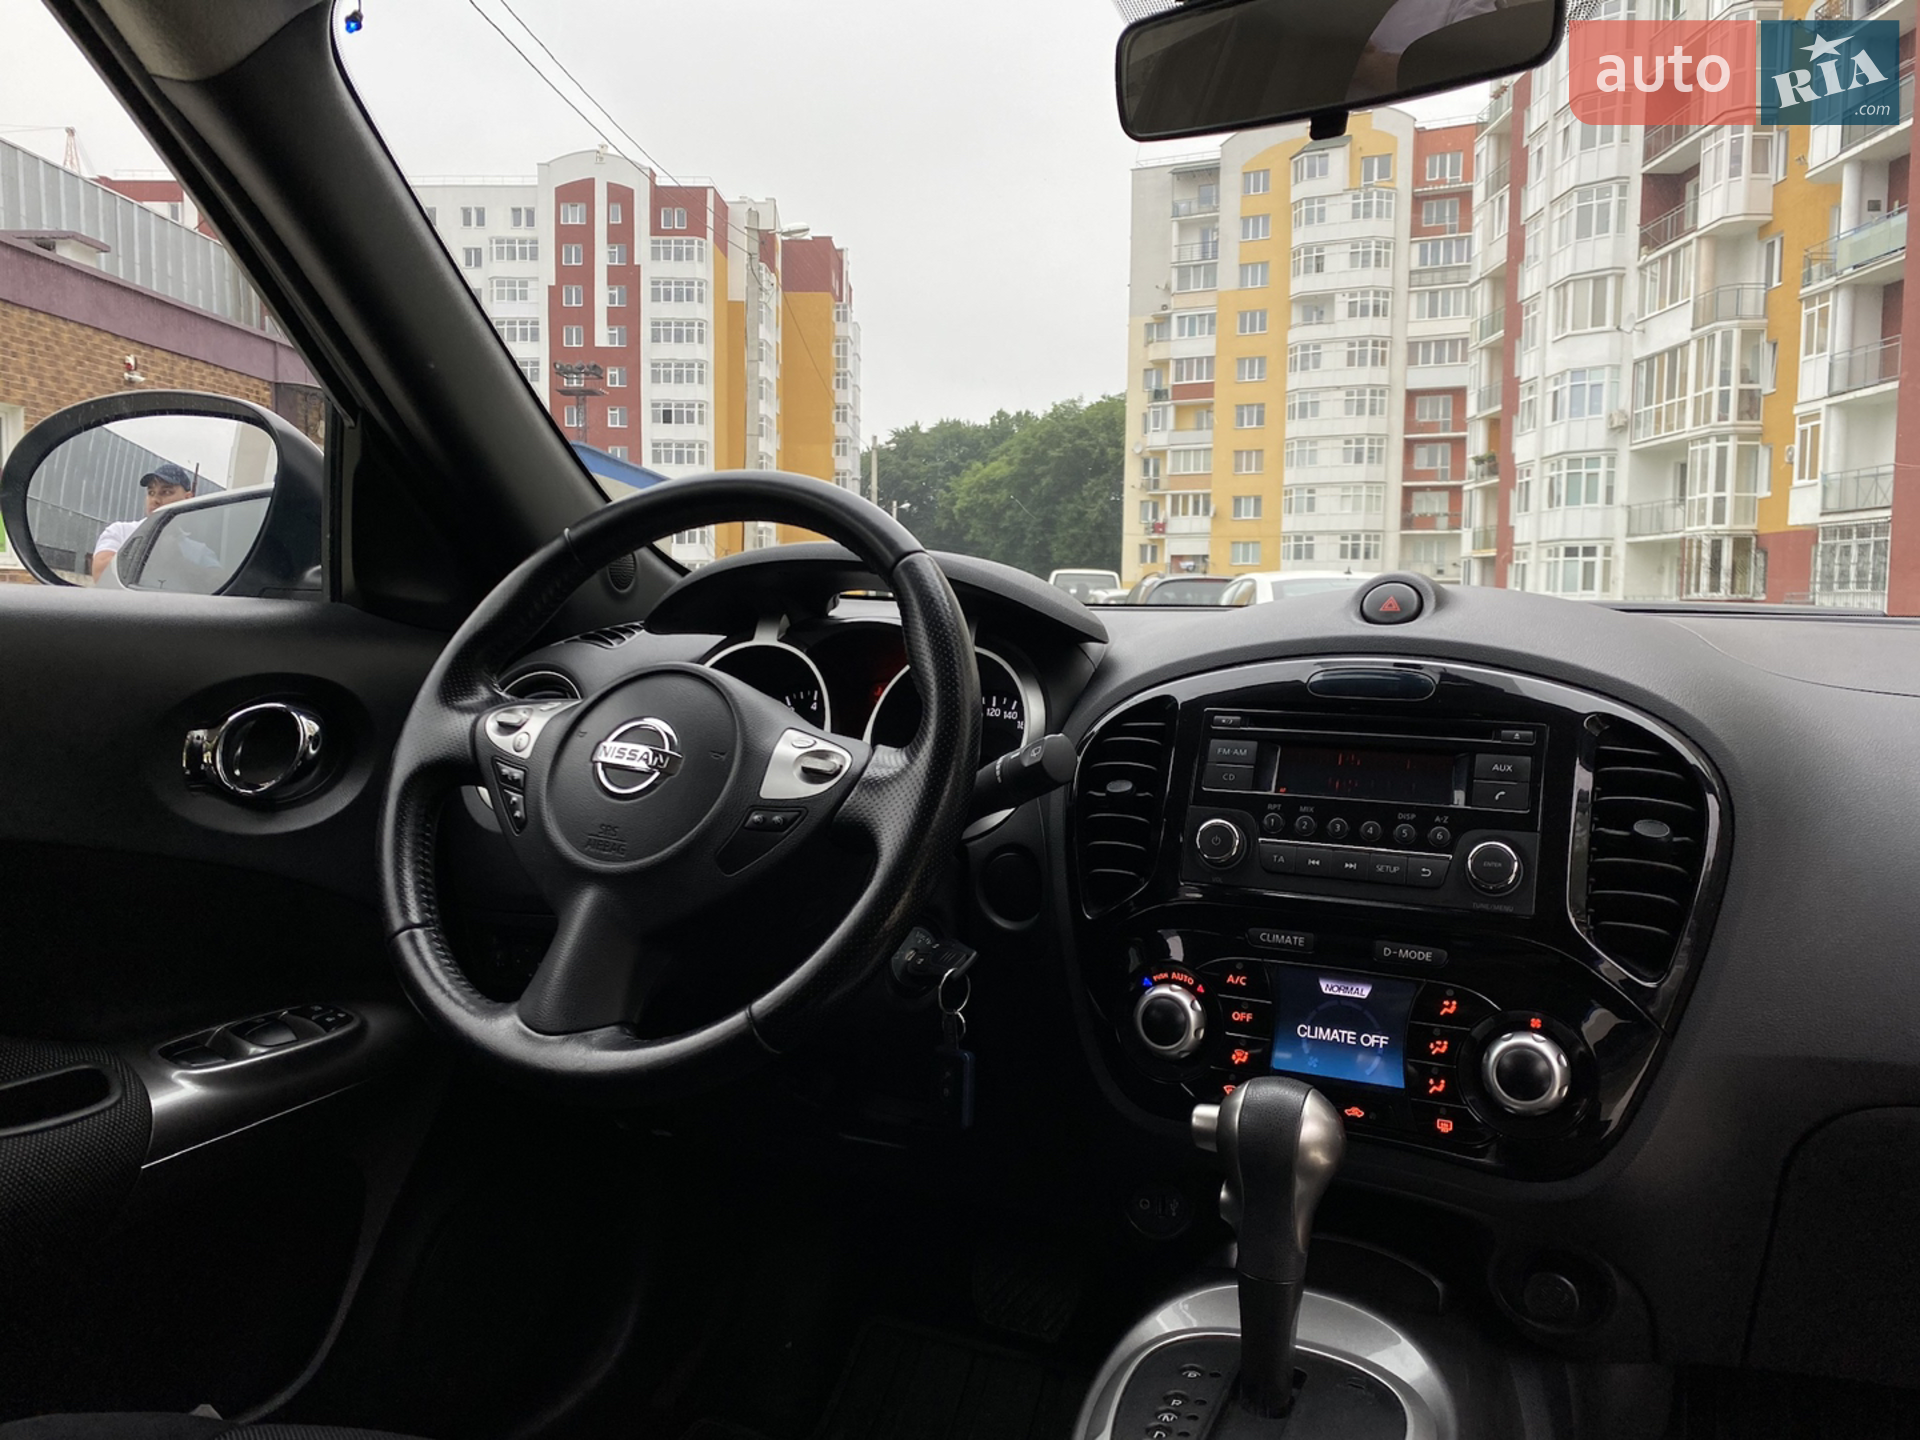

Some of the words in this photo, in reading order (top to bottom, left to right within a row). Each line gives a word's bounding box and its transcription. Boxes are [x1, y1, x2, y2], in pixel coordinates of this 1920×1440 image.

[810, 701, 818, 711] 4
[986, 708, 1001, 717] 120
[1003, 711, 1018, 720] 140
[602, 745, 670, 768] NISSAN
[1491, 763, 1513, 772] AUX
[1222, 772, 1236, 781] CD
[1267, 803, 1282, 811] RPT
[1299, 805, 1315, 813] MIX
[1397, 812, 1416, 821] DISP
[586, 837, 627, 856] AIRBAG
[1273, 854, 1285, 863] TA
[1375, 864, 1400, 873] SETUP
[1259, 932, 1305, 946] CLIMATE
[1382, 947, 1433, 961] D-MODE
[1171, 971, 1194, 985] AUTO
[1226, 974, 1247, 986] A/C
[1325, 983, 1366, 997] NORMAL
[1231, 1011, 1253, 1022] OFF
[1297, 1024, 1357, 1045] CLIMATE
[1360, 1033, 1389, 1048] OFF
